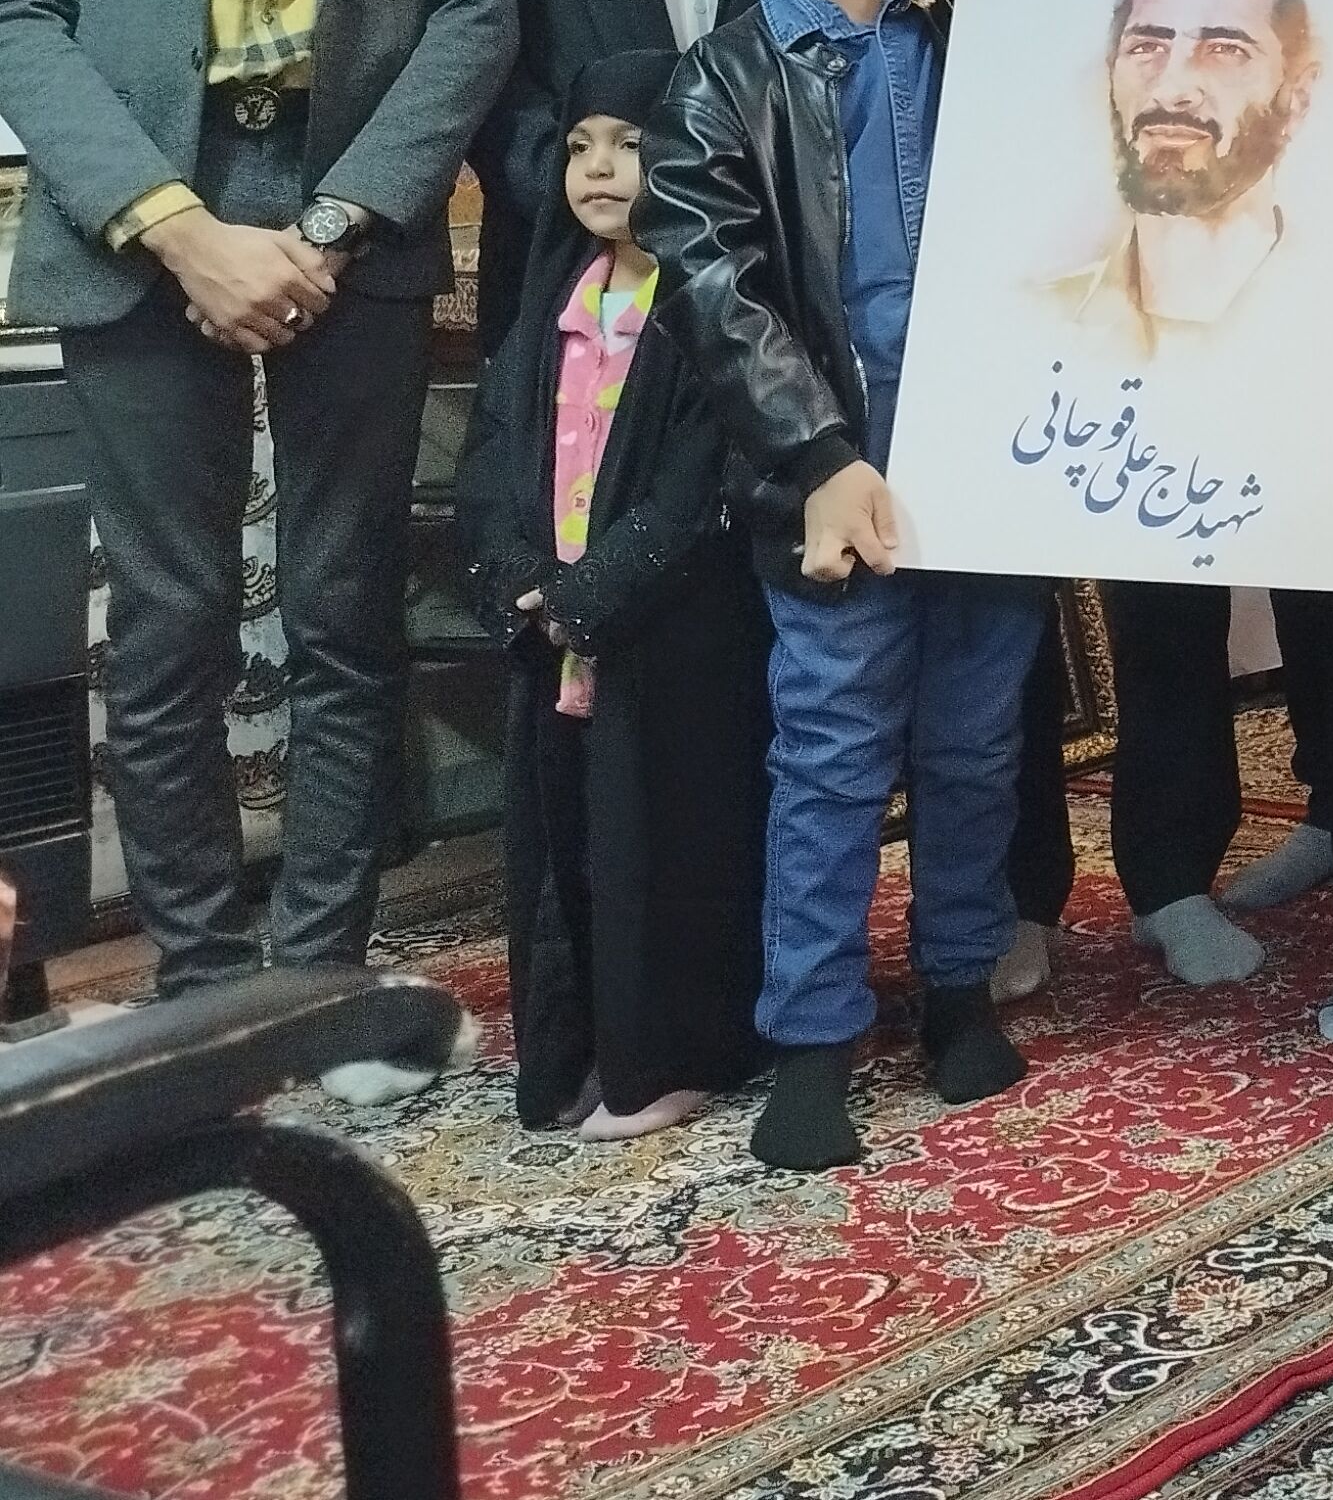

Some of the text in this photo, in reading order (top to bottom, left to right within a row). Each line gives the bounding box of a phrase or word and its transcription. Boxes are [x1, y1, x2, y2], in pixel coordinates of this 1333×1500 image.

[1010, 359, 1266, 570] شهید حاج علی قوچانی
